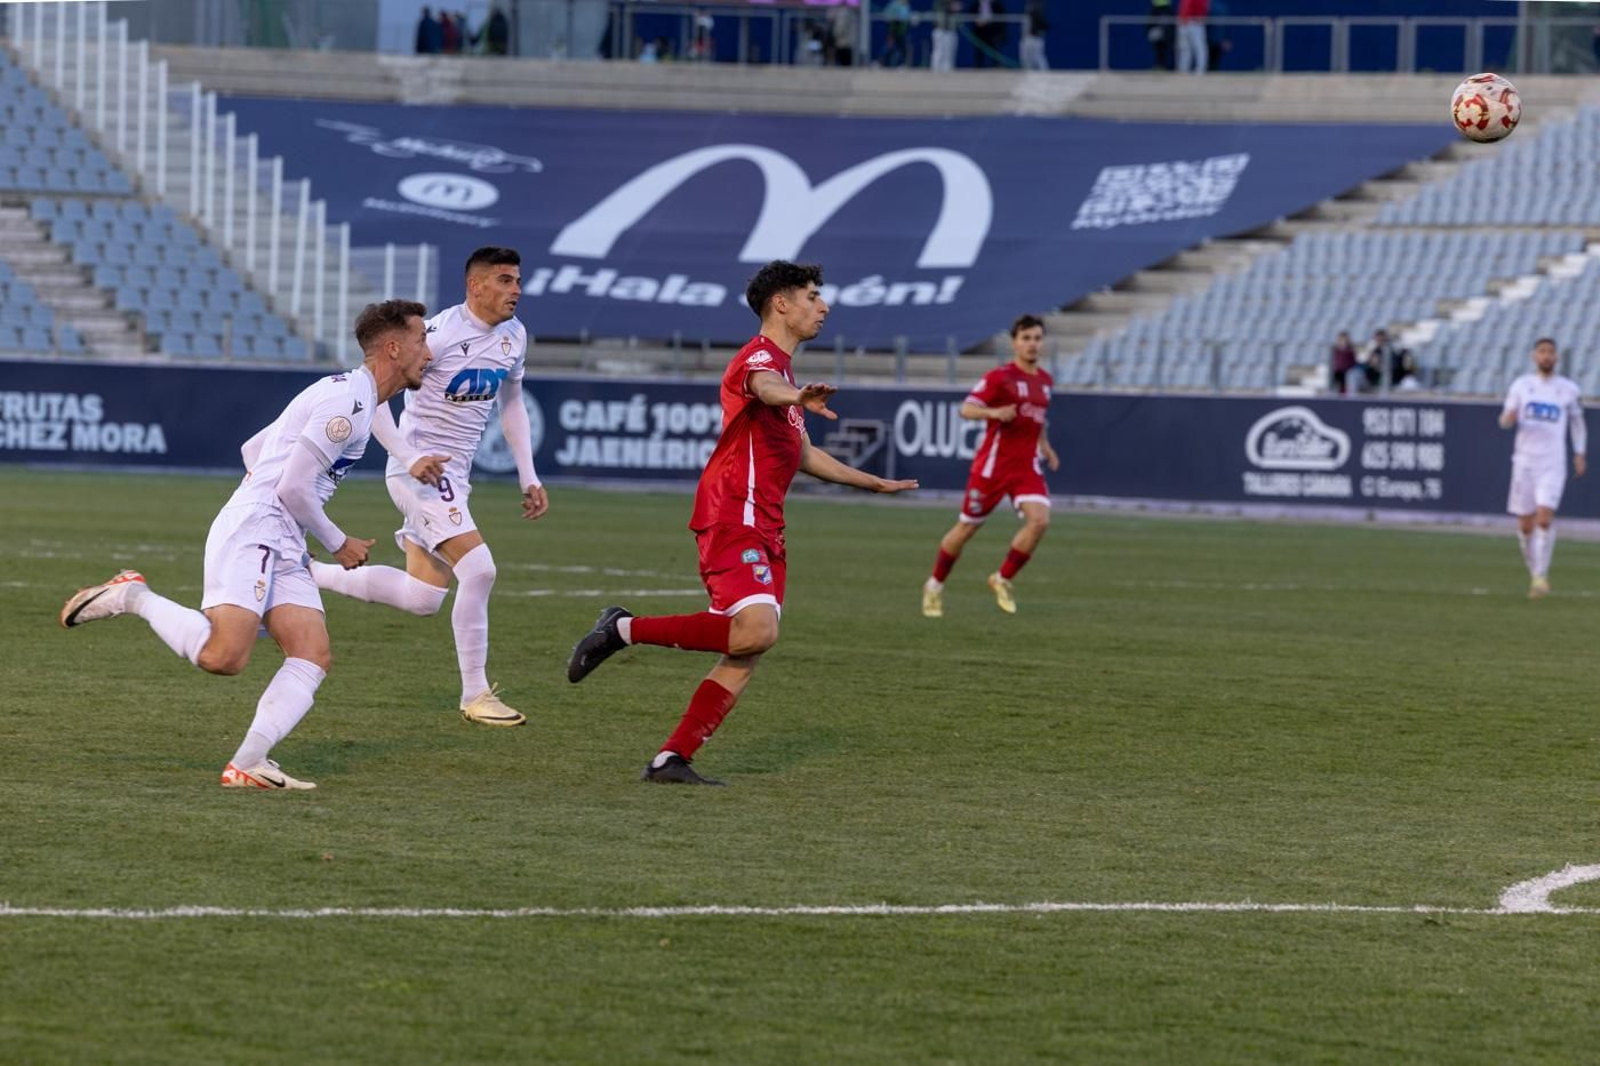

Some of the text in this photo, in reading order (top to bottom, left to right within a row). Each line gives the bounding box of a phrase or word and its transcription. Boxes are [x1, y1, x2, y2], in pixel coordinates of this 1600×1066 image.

[523, 265, 965, 307] ¡Hala én!
[0, 391, 103, 423] RUTAS
[559, 394, 647, 432] CAFÉ
[71, 421, 167, 453] MORA
[555, 431, 717, 469] JAENÉRIC
[437, 476, 455, 502] 9
[257, 543, 271, 574] 7
